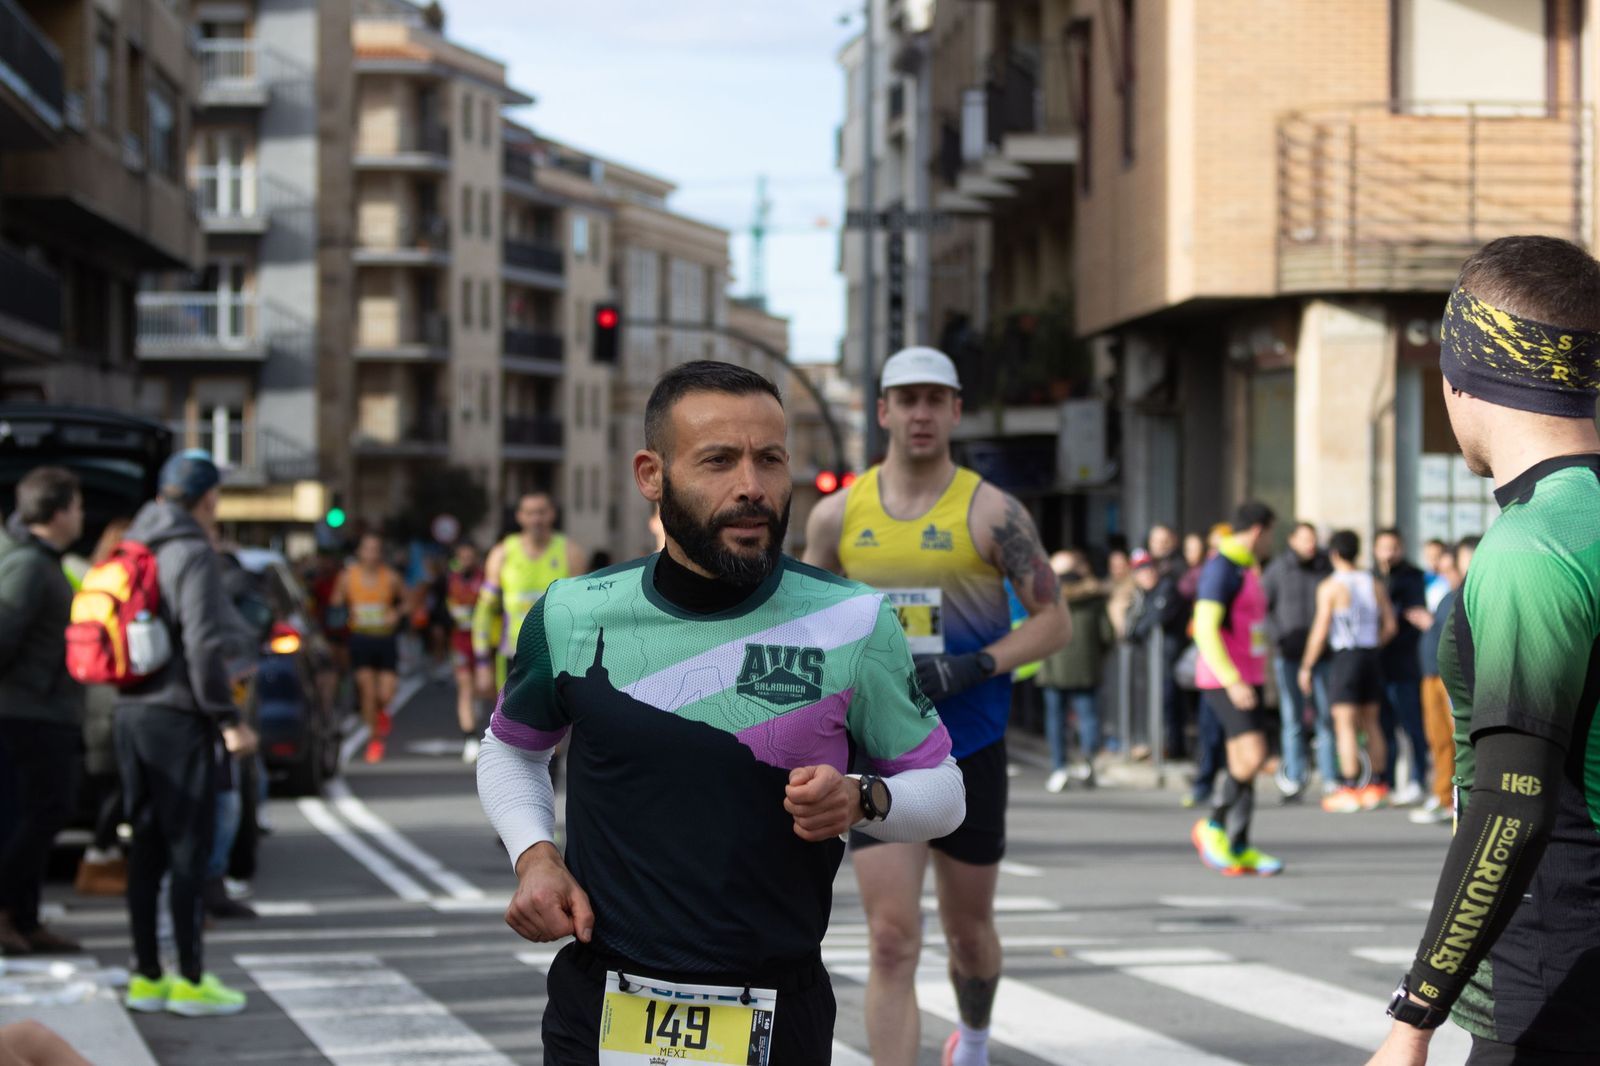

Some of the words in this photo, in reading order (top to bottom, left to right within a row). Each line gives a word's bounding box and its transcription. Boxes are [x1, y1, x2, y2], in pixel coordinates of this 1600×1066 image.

[888, 592, 931, 604] ETEL
[644, 999, 711, 1050] 149
[659, 1047, 687, 1059] MEXI
